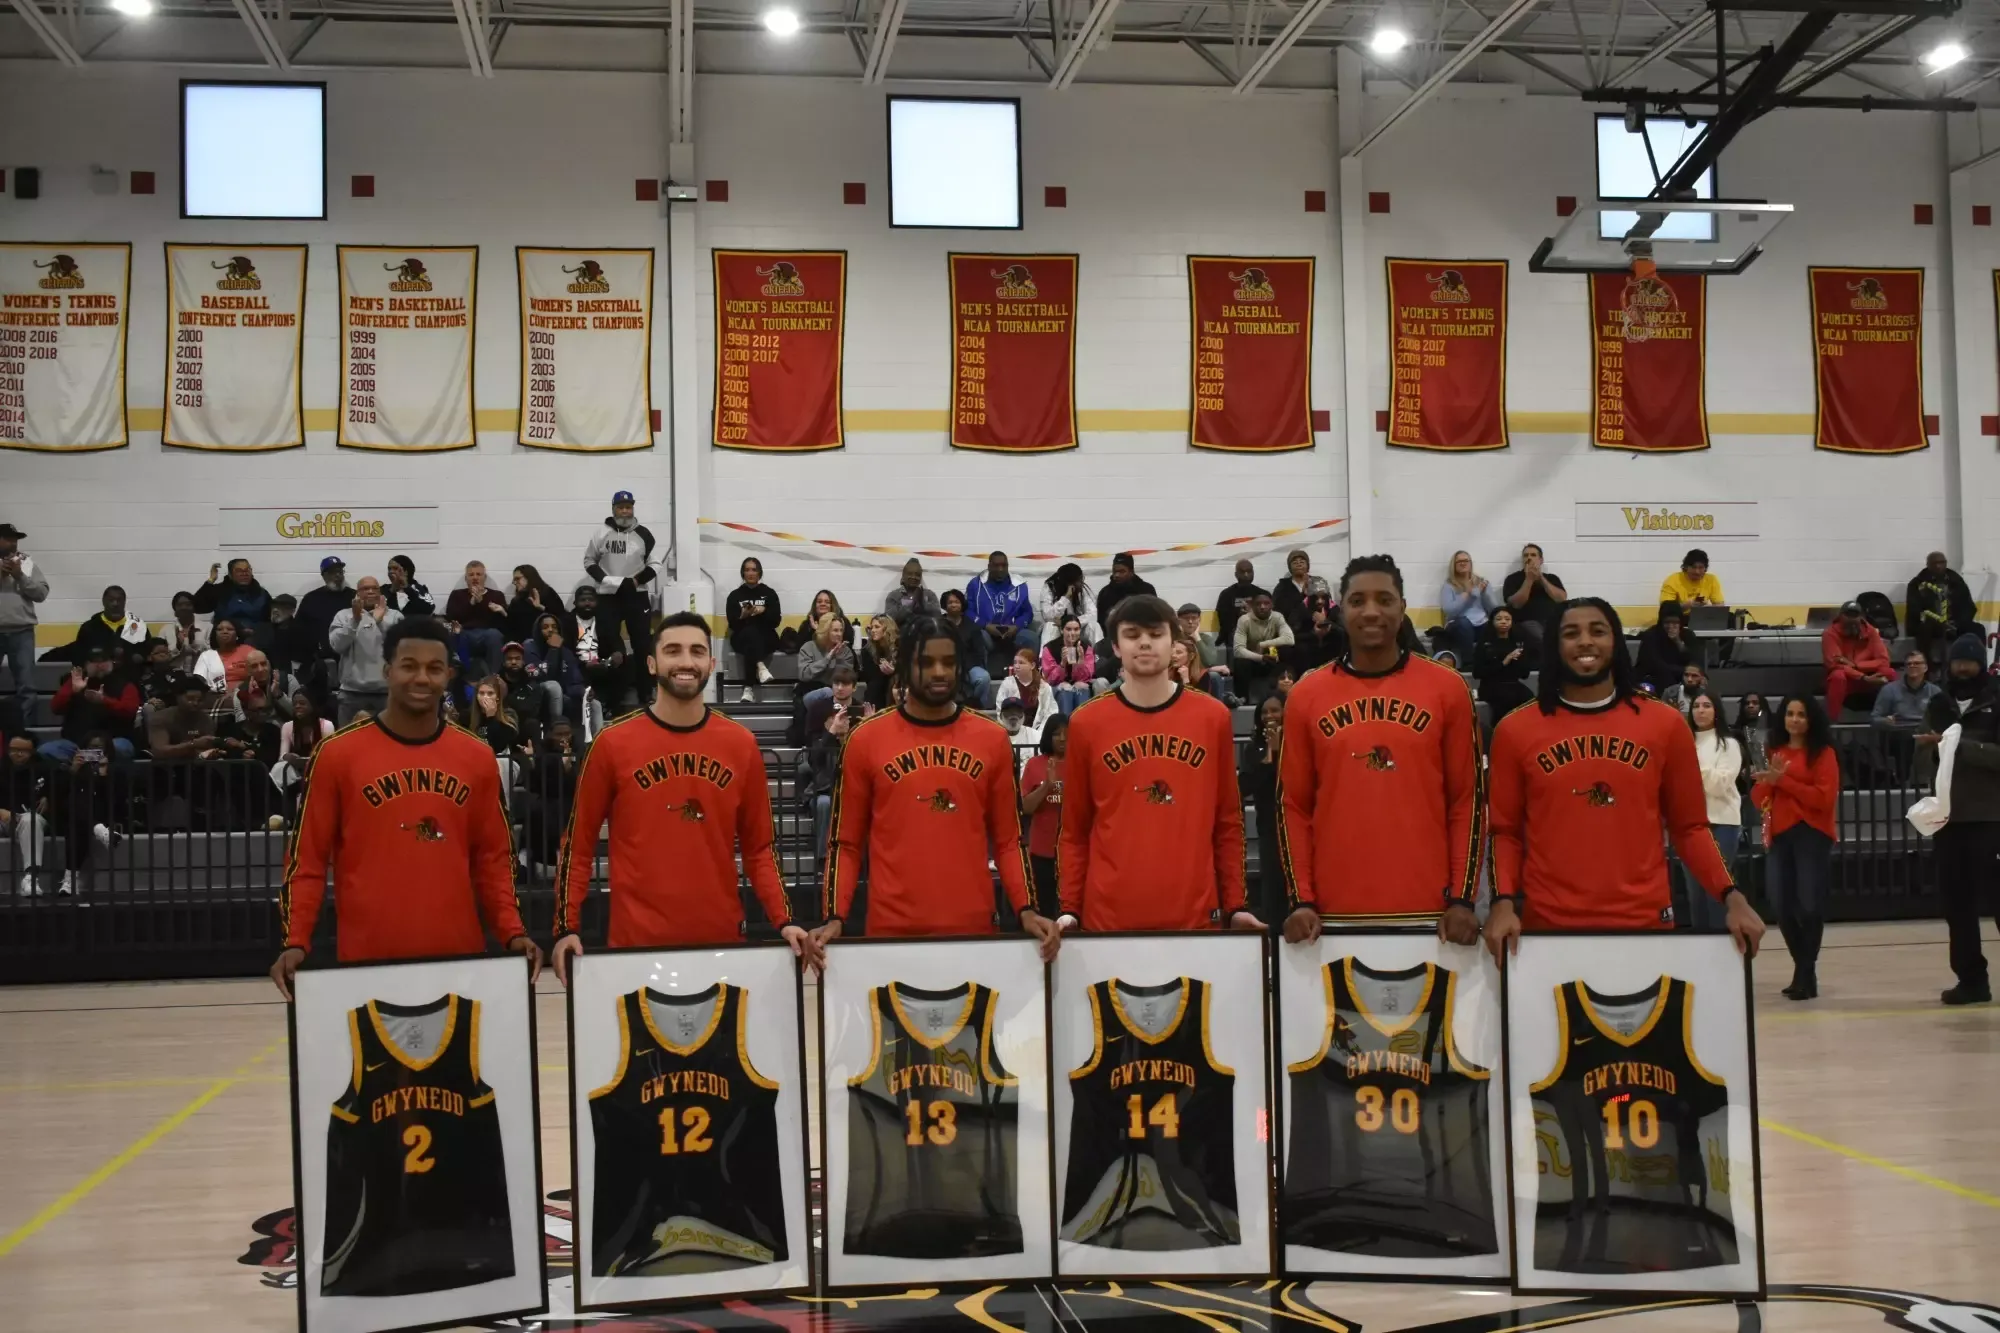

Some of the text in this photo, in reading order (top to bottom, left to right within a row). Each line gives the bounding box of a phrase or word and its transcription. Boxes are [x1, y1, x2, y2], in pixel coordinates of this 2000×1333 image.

[3, 295, 116, 308] WOMEN'S TENNIS
[201, 295, 270, 310] BASEBALL
[350, 296, 466, 312] MEN'S BASKETBALL
[530, 298, 642, 313] WOMEN'S BASKETBALL
[725, 299, 835, 314] WOMEN'S BASKETBALL
[960, 303, 1068, 316] MEN'S BASKETBALL
[1222, 305, 1282, 317] BASEBALL
[1400, 306, 1494, 320] WOMEN'S TENNIS
[1608, 309, 1643, 323] FIE
[0, 312, 119, 327] CONFERENCE CHAMPIONS
[178, 312, 295, 327] CONFERENCE CHAMPIONS
[349, 313, 467, 328] CONFERENCE CHAMPIONS
[529, 314, 644, 330] CONFERENCE CHAMPIONS
[728, 317, 832, 331] NCAA TOURNAMENT
[964, 319, 1065, 333] NCAA TOURNAMENT
[1821, 313, 1917, 327] WOMEN'S LACROSSE
[1204, 320, 1300, 335] NCAA TOURNAMENT
[1402, 323, 1495, 337] NCAA TOURNAMENT
[0, 330, 57, 343] 2008 2016
[178, 329, 202, 342] 2000
[350, 331, 376, 345] 1999
[529, 331, 555, 345] 2000
[724, 333, 779, 348] 1999 2012
[960, 336, 985, 349] 2004
[1823, 329, 1914, 342] NCAA TOURNAMENT
[1200, 336, 1223, 350] 2000
[1423, 340, 1446, 353] 2017
[1820, 343, 1843, 356] 2011
[0, 346, 57, 360] 2009 2018
[176, 346, 202, 359] 2001
[351, 347, 375, 360] 2004
[531, 347, 555, 361] 2001
[724, 349, 779, 363] 2000 2017
[961, 351, 985, 365] 2005
[1200, 352, 1224, 365] 2001
[176, 361, 202, 375] 2007
[1423, 355, 1446, 367] 2018
[0, 362, 25, 375] 2010
[350, 363, 375, 375] 2005
[531, 364, 555, 376] 2003
[724, 364, 749, 377] 2001
[960, 366, 985, 380] 2009
[1200, 367, 1224, 380] 2006
[1397, 368, 1421, 381] 2010
[0, 378, 24, 391] 2011
[176, 378, 202, 391] 2008
[350, 379, 375, 392] 2009
[530, 380, 555, 392] 2006
[723, 380, 749, 393] 2003
[960, 381, 985, 395] 2011
[1199, 382, 1224, 395] 2007
[1601, 384, 1622, 398] 203
[0, 394, 24, 408] 2013
[175, 394, 202, 407] 2019
[350, 394, 375, 408] 2016
[530, 395, 555, 408] 2007
[723, 395, 748, 409] 2004
[960, 397, 986, 409] 2016
[0, 410, 25, 423] 2014
[349, 410, 376, 424] 2019
[529, 411, 556, 424] 2012
[723, 411, 748, 424] 2006
[959, 412, 986, 425] 2019
[1398, 411, 1420, 425] 2015
[1601, 413, 1624, 426] 2017
[0, 426, 24, 439] 2015
[528, 426, 555, 439] 2017
[722, 427, 747, 440] 2007
[1398, 426, 1420, 439] 2016
[1600, 428, 1624, 441] 2018
[276, 511, 385, 539] Griffins
[1621, 507, 1714, 531] Visitors
[1317, 696, 1432, 739] GWYNEDD
[1102, 733, 1206, 774] GWYNEDD
[1536, 734, 1649, 776] GWYNEDD
[883, 744, 984, 783] GWYNEDD
[633, 752, 734, 791] GWYNEDD
[362, 768, 471, 808] GWYNEDD
[1110, 1059, 1196, 1090] GWYNEDD
[1347, 1050, 1431, 1086] GWYNEDD
[889, 1063, 976, 1097] GWYNEDD
[1583, 1061, 1677, 1096] GWYNEDD
[640, 1070, 729, 1104] GWYNEDD
[371, 1086, 465, 1124] GWYNEDD
[1355, 1085, 1421, 1135] 30
[905, 1099, 958, 1146] 13
[1126, 1093, 1181, 1139] 14
[657, 1106, 714, 1155] 12
[1602, 1100, 1660, 1150] 10
[402, 1124, 436, 1174] 2
